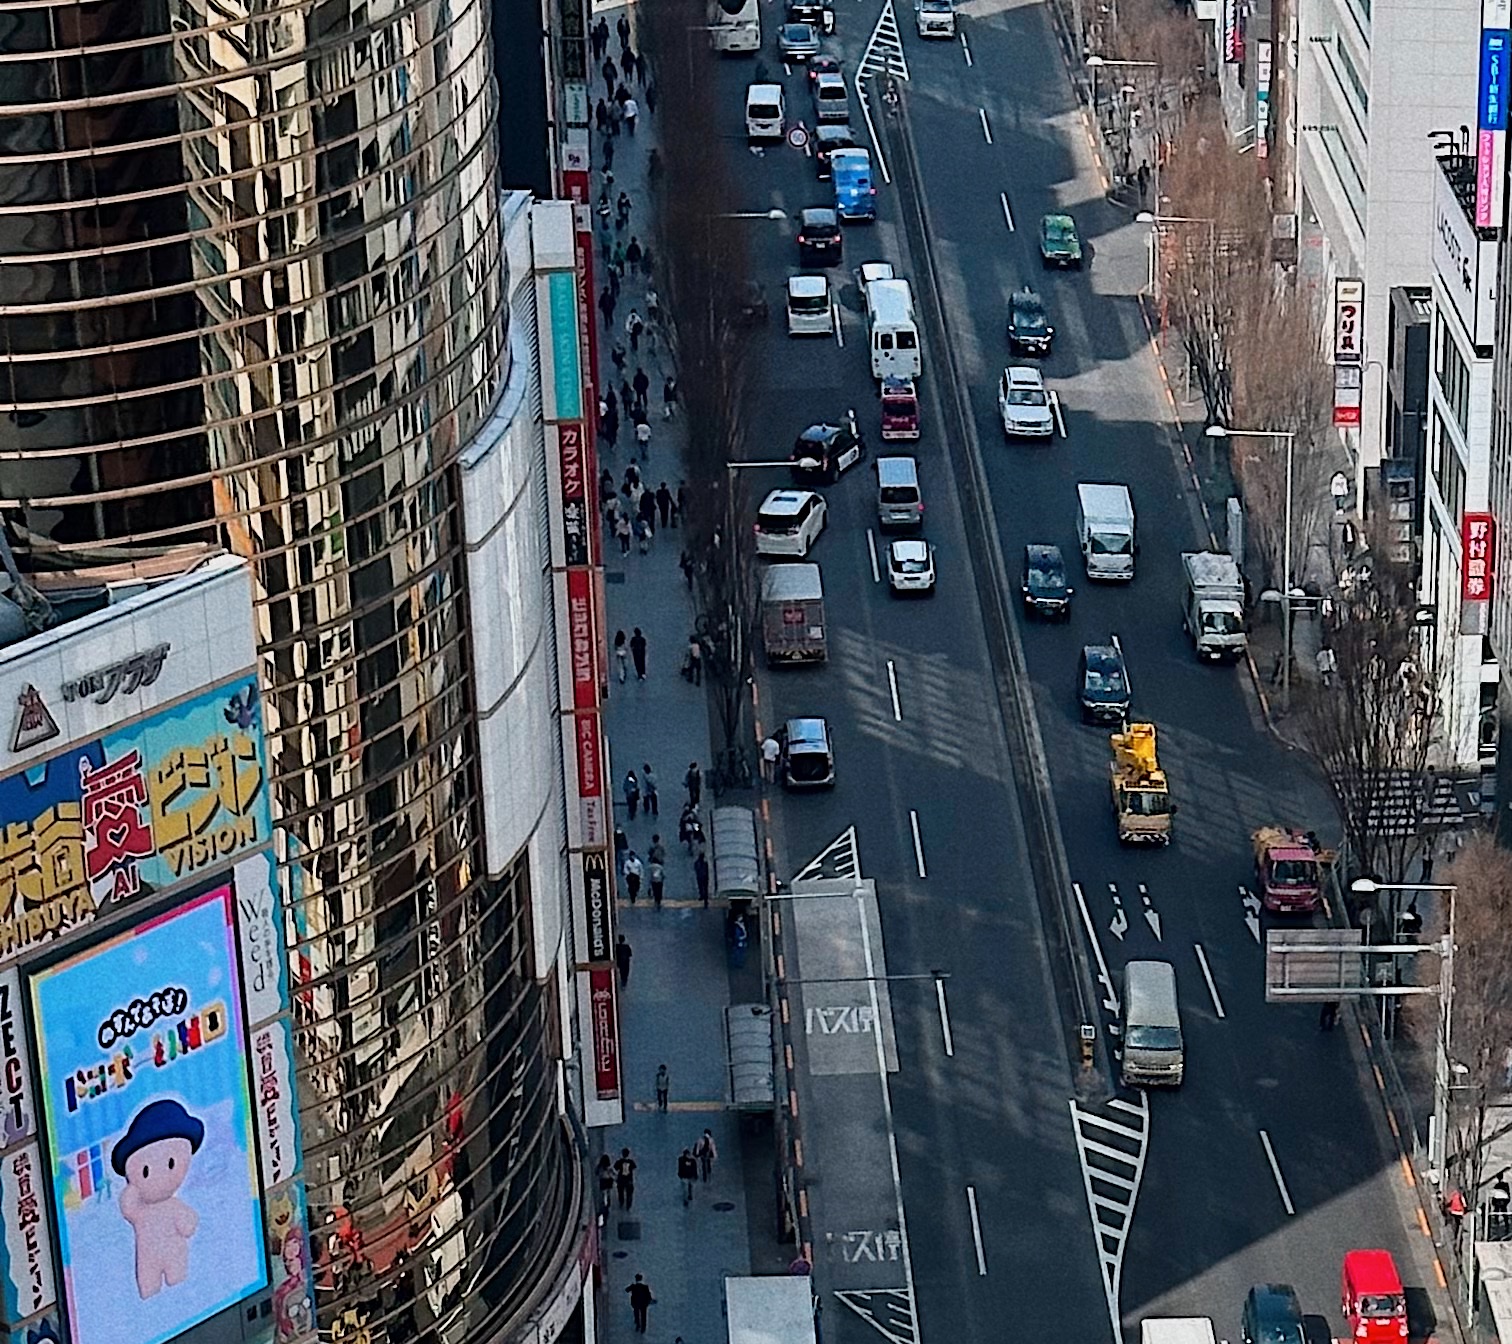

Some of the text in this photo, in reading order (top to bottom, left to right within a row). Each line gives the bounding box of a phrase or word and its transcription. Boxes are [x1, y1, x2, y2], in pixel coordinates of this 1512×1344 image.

[561, 428, 582, 495] カラオケ
[0, 815, 258, 957] HIBUYA AI VISION
[590, 878, 604, 957] McDonald's
[805, 1004, 876, 1036] バス停
